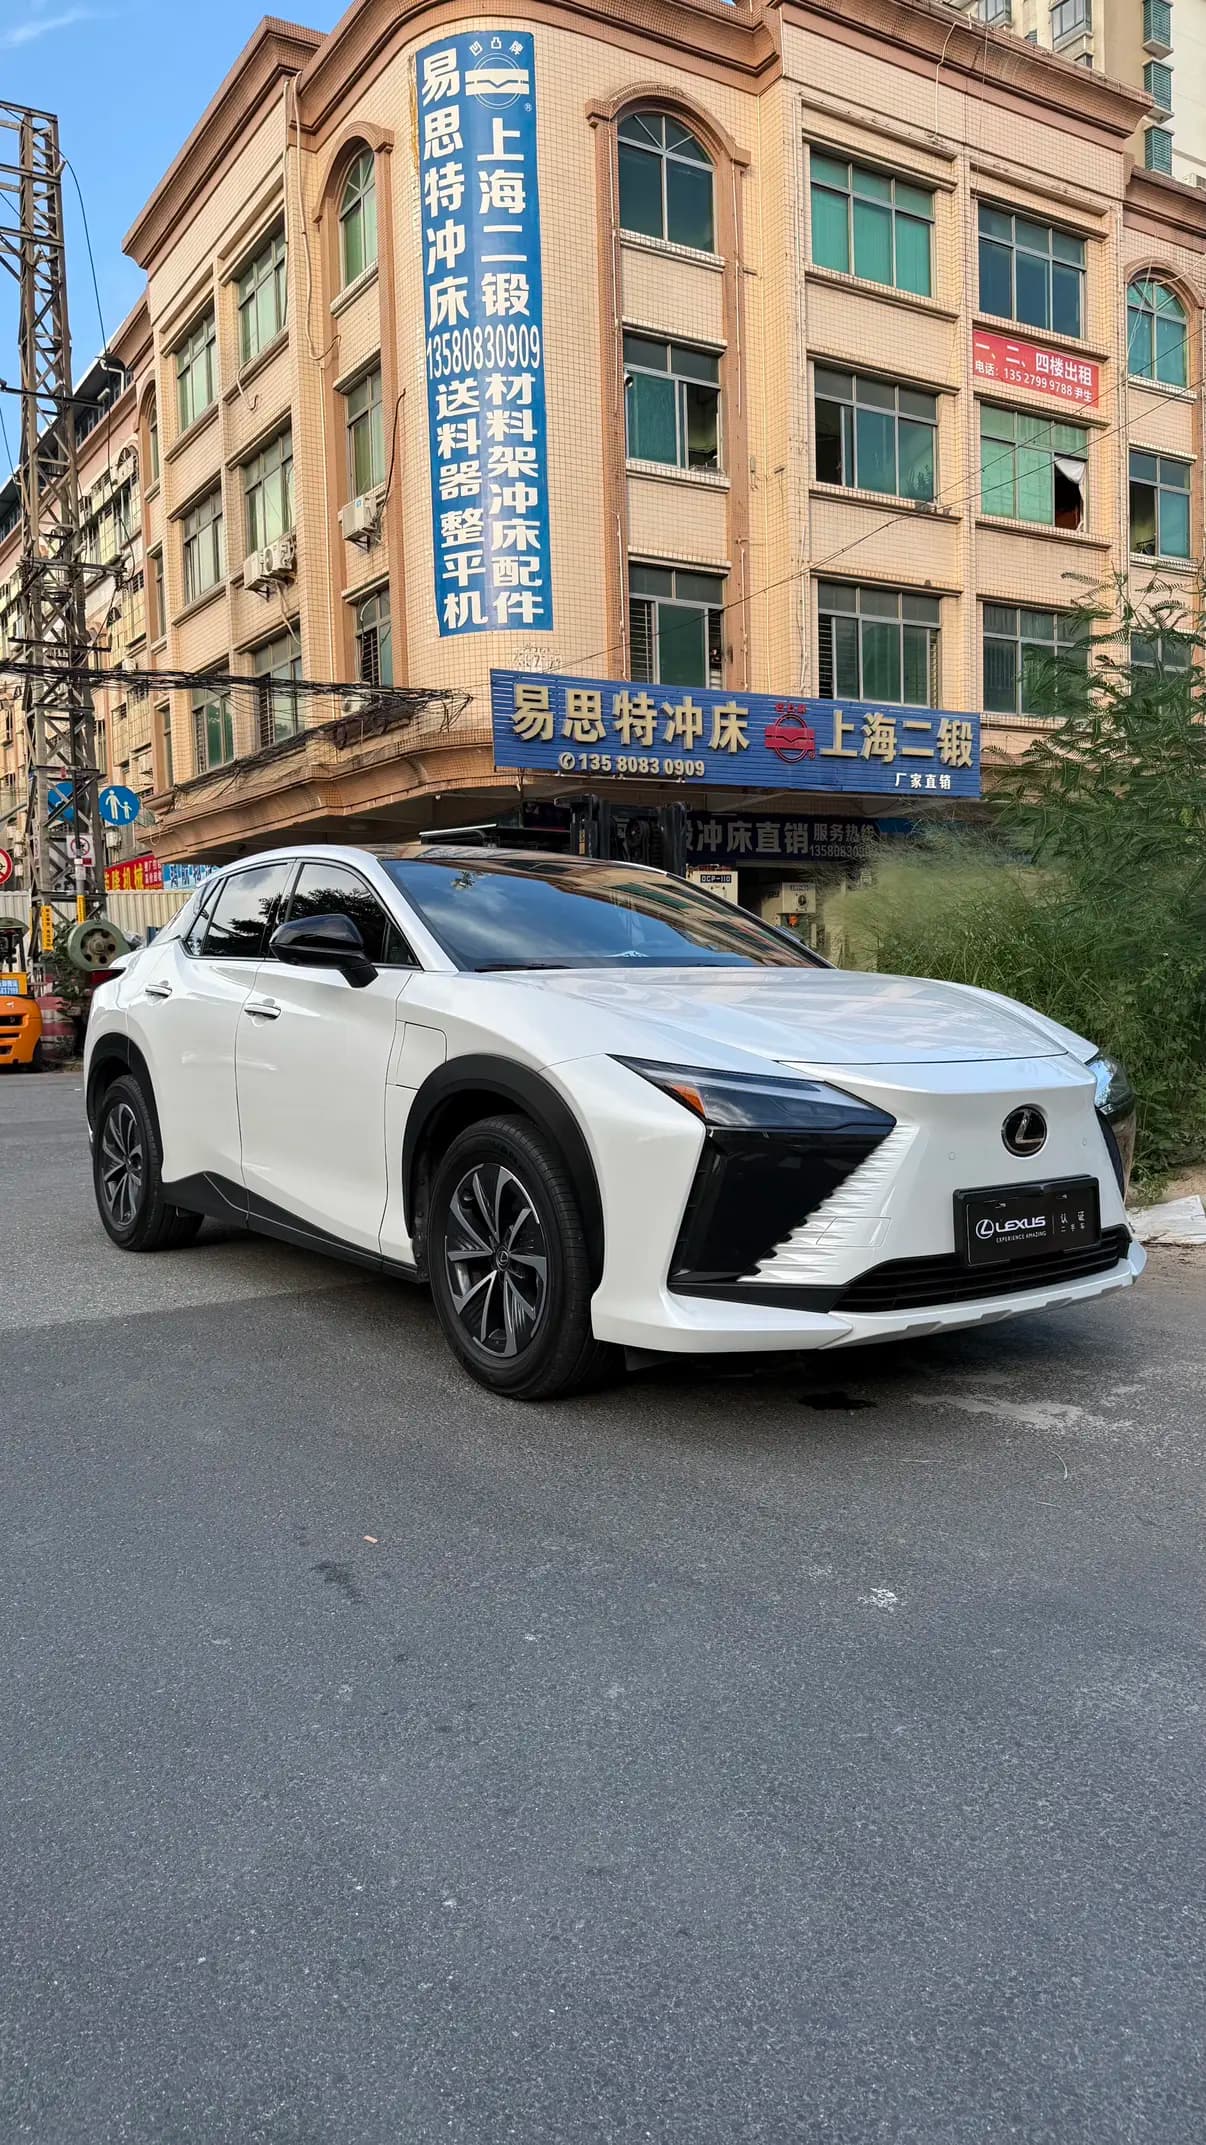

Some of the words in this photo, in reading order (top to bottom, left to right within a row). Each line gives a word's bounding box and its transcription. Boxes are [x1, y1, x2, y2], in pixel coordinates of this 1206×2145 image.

[421, 48, 469, 331] 易思特冲床
[476, 118, 530, 317] 上海二锻
[427, 323, 540, 380] 13580830909
[1004, 368, 1022, 382] 135
[1024, 373, 1047, 388] 2799
[1049, 381, 1073, 396] 9788
[485, 373, 544, 624] 材料架冲床配件
[512, 684, 750, 753] 易思特冲床
[819, 709, 973, 768] 上海二锻
[579, 753, 611, 772] 135
[617, 757, 660, 774] 8083
[665, 760, 705, 777] 0909
[895, 773, 951, 790] 厂家直销
[996, 1216, 1046, 1232] LEXUS
[996, 1233, 1025, 1243] EXPERIENCE
[1026, 1230, 1047, 1240] AMAZING
